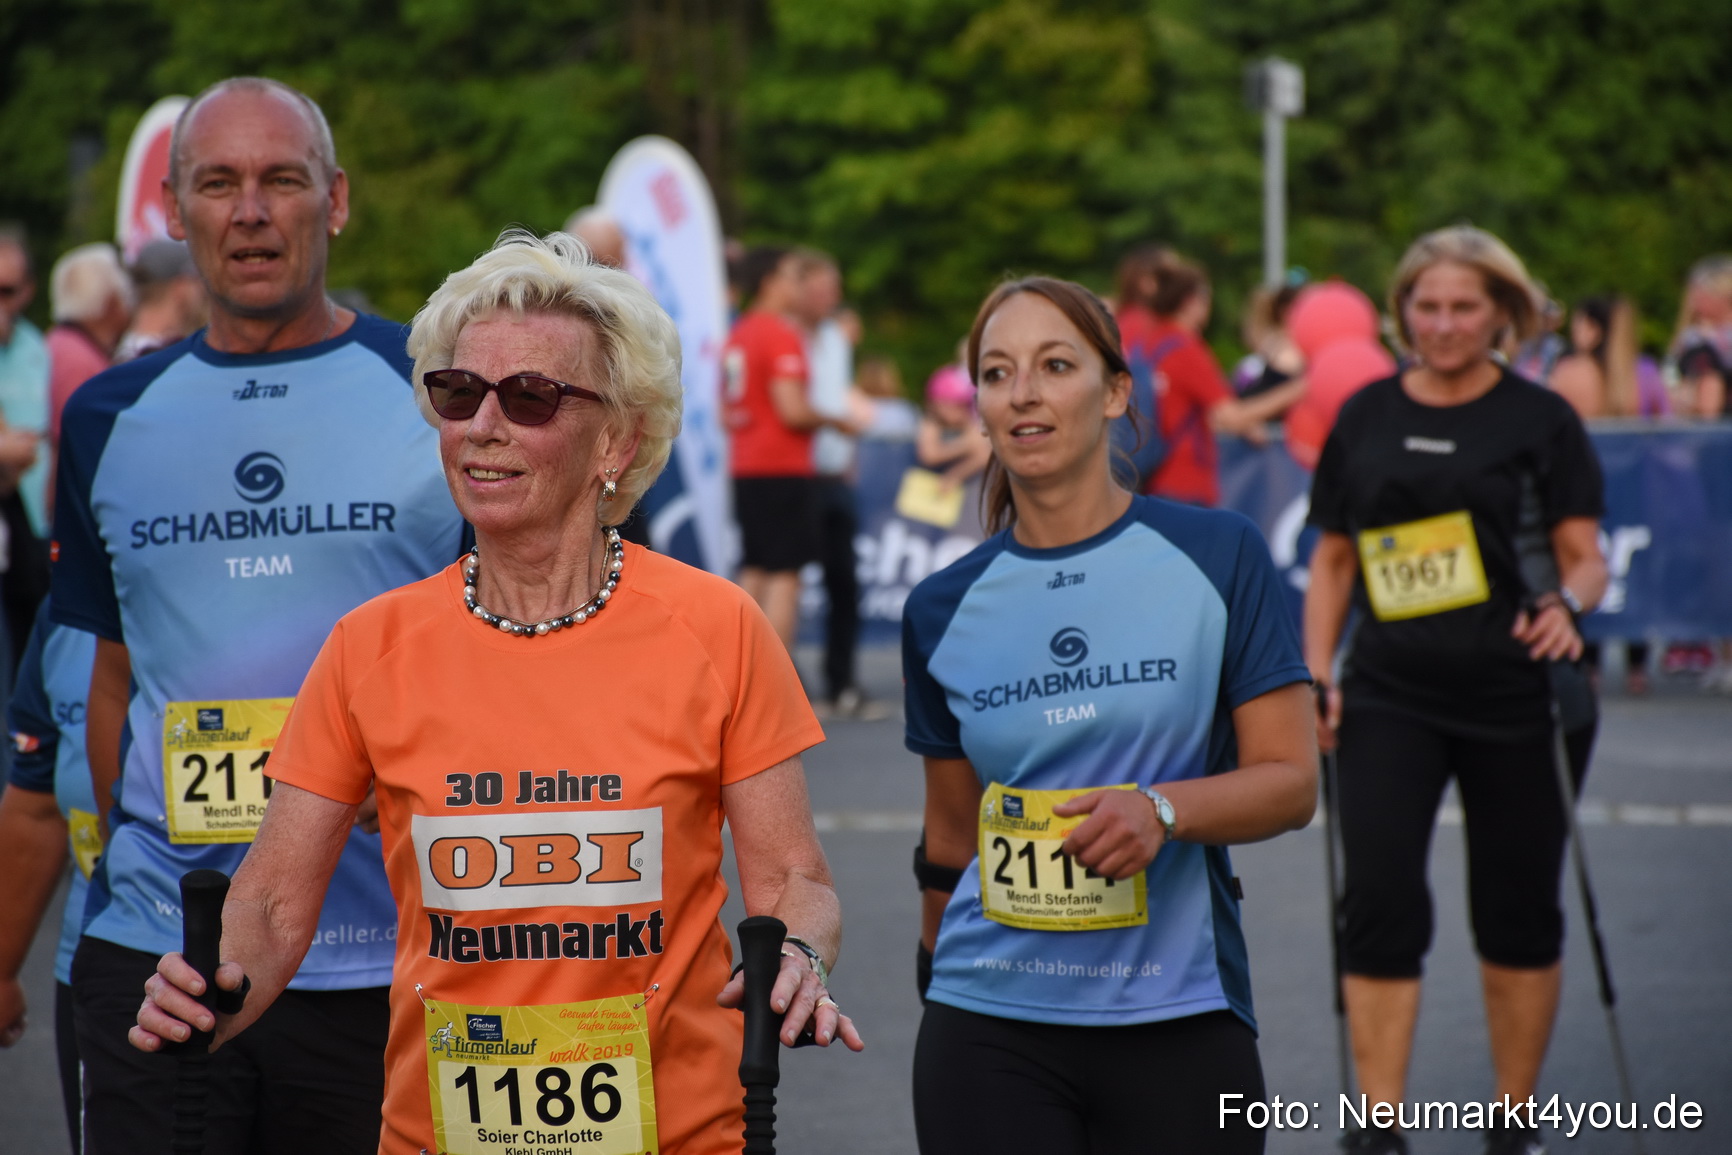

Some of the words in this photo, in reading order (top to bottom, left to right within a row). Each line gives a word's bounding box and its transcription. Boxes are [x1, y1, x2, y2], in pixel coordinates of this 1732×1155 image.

[130, 502, 397, 550] SCHABMÜLLER
[225, 554, 293, 578] TEAM
[1381, 549, 1457, 594] 1967
[972, 658, 1177, 712] SCHABMÜLLER
[1044, 703, 1097, 726] TEAM
[182, 751, 273, 802] 211
[445, 771, 503, 807] 30
[515, 769, 622, 805] Jahre
[203, 805, 242, 818] Mendl
[247, 804, 266, 816] Ro
[1006, 889, 1041, 901] Mendl
[1045, 893, 1103, 906] Stefanie
[1011, 905, 1063, 916] Schabmüller
[1066, 908, 1097, 916] GmbH
[427, 908, 664, 965] Neumarkt
[559, 1008, 599, 1019] Gesunde
[601, 1009, 632, 1019] Firmen
[473, 1021, 497, 1029] Fischer
[577, 1020, 605, 1032] laufen
[608, 1021, 641, 1035] länger!
[455, 1037, 538, 1054] firmenlauf
[549, 1043, 590, 1063] walk
[592, 1042, 634, 1060] 2019
[455, 1062, 622, 1127] 1186
[477, 1128, 519, 1144] Soier
[523, 1128, 603, 1144] Charlotte
[536, 1147, 572, 1155] GmbH
